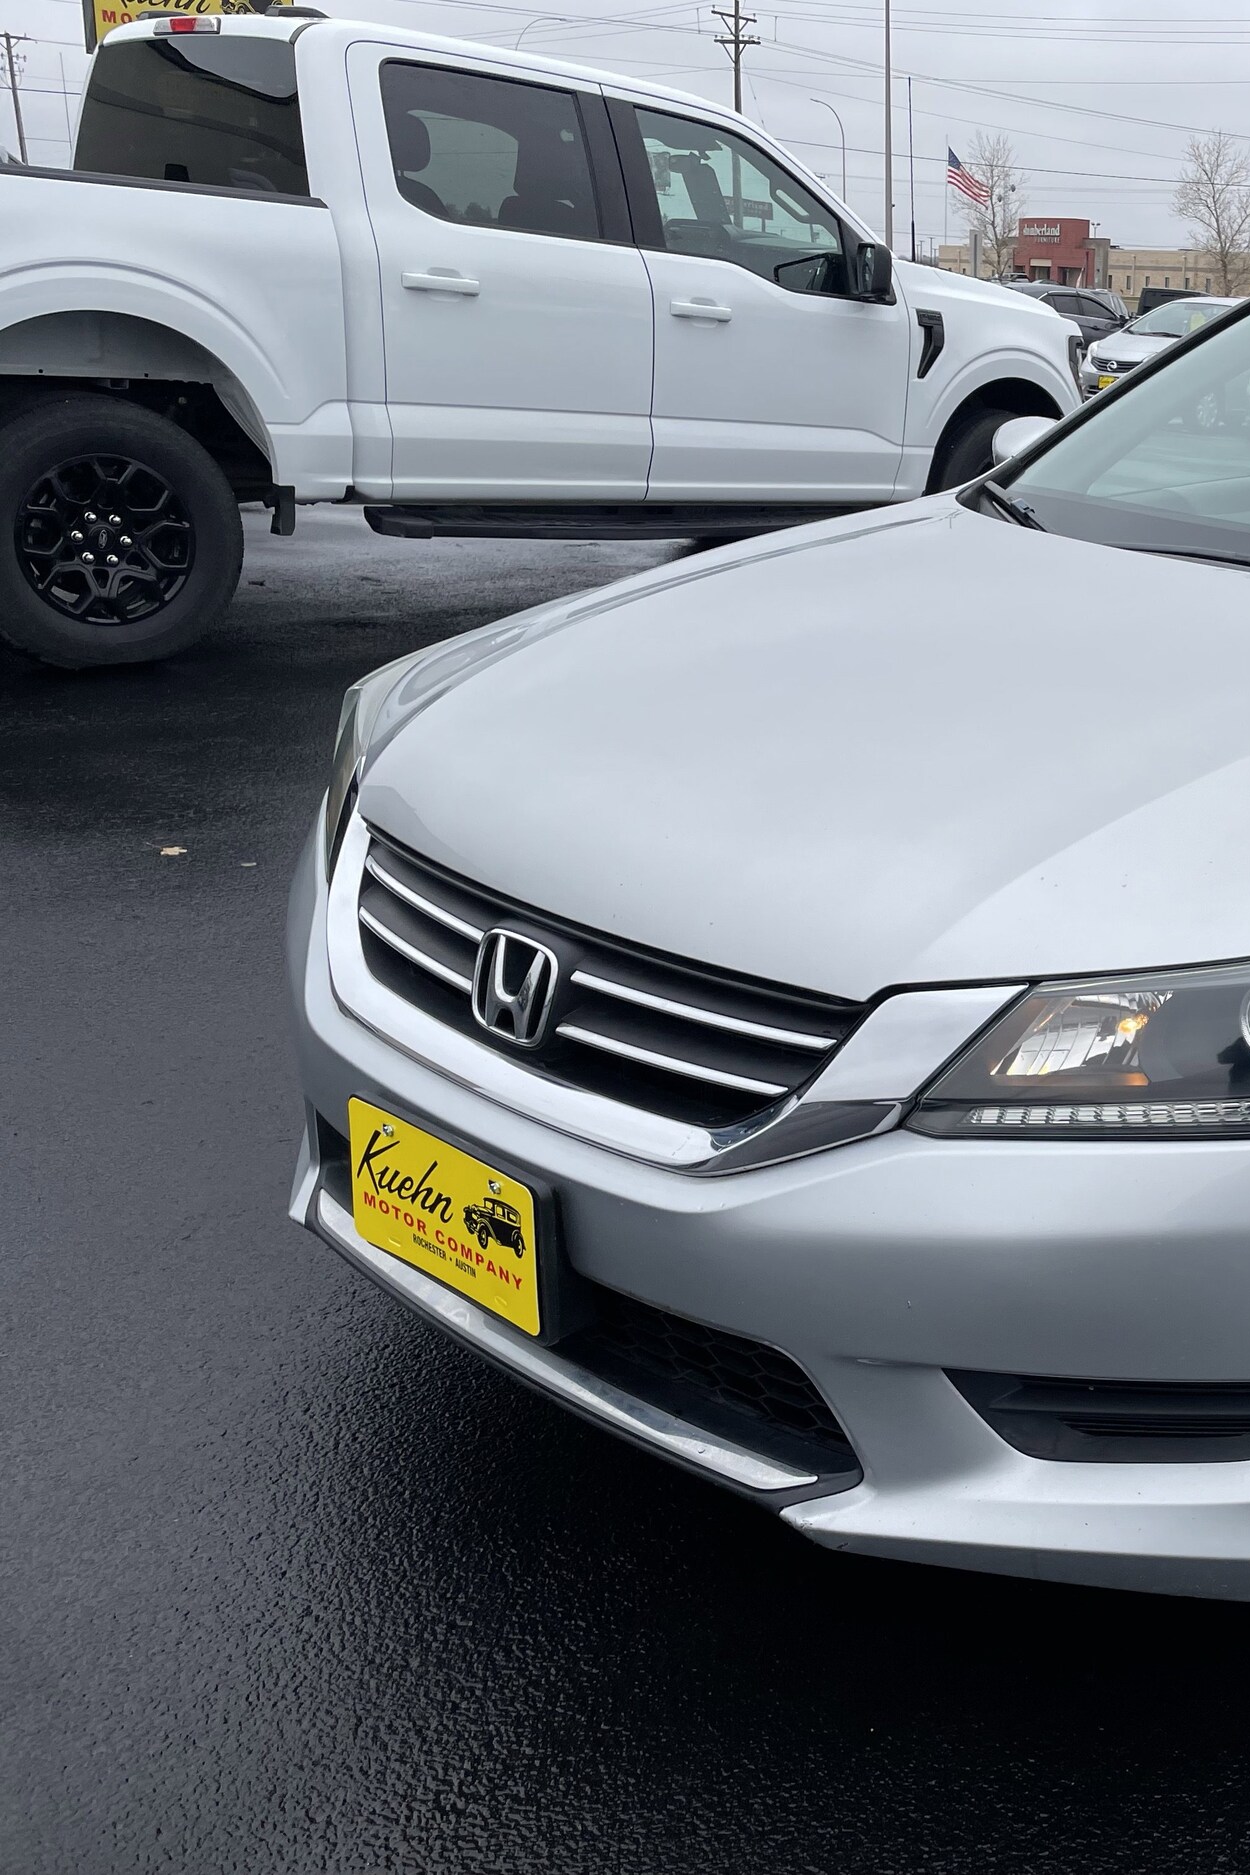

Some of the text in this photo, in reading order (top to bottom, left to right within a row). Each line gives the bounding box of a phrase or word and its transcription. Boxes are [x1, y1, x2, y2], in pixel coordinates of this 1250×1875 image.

[357, 1129, 454, 1224] Kuehn
[363, 1190, 523, 1291] MOTOR COMPANY
[412, 1233, 477, 1278] ROCHESTER AUSTIN
